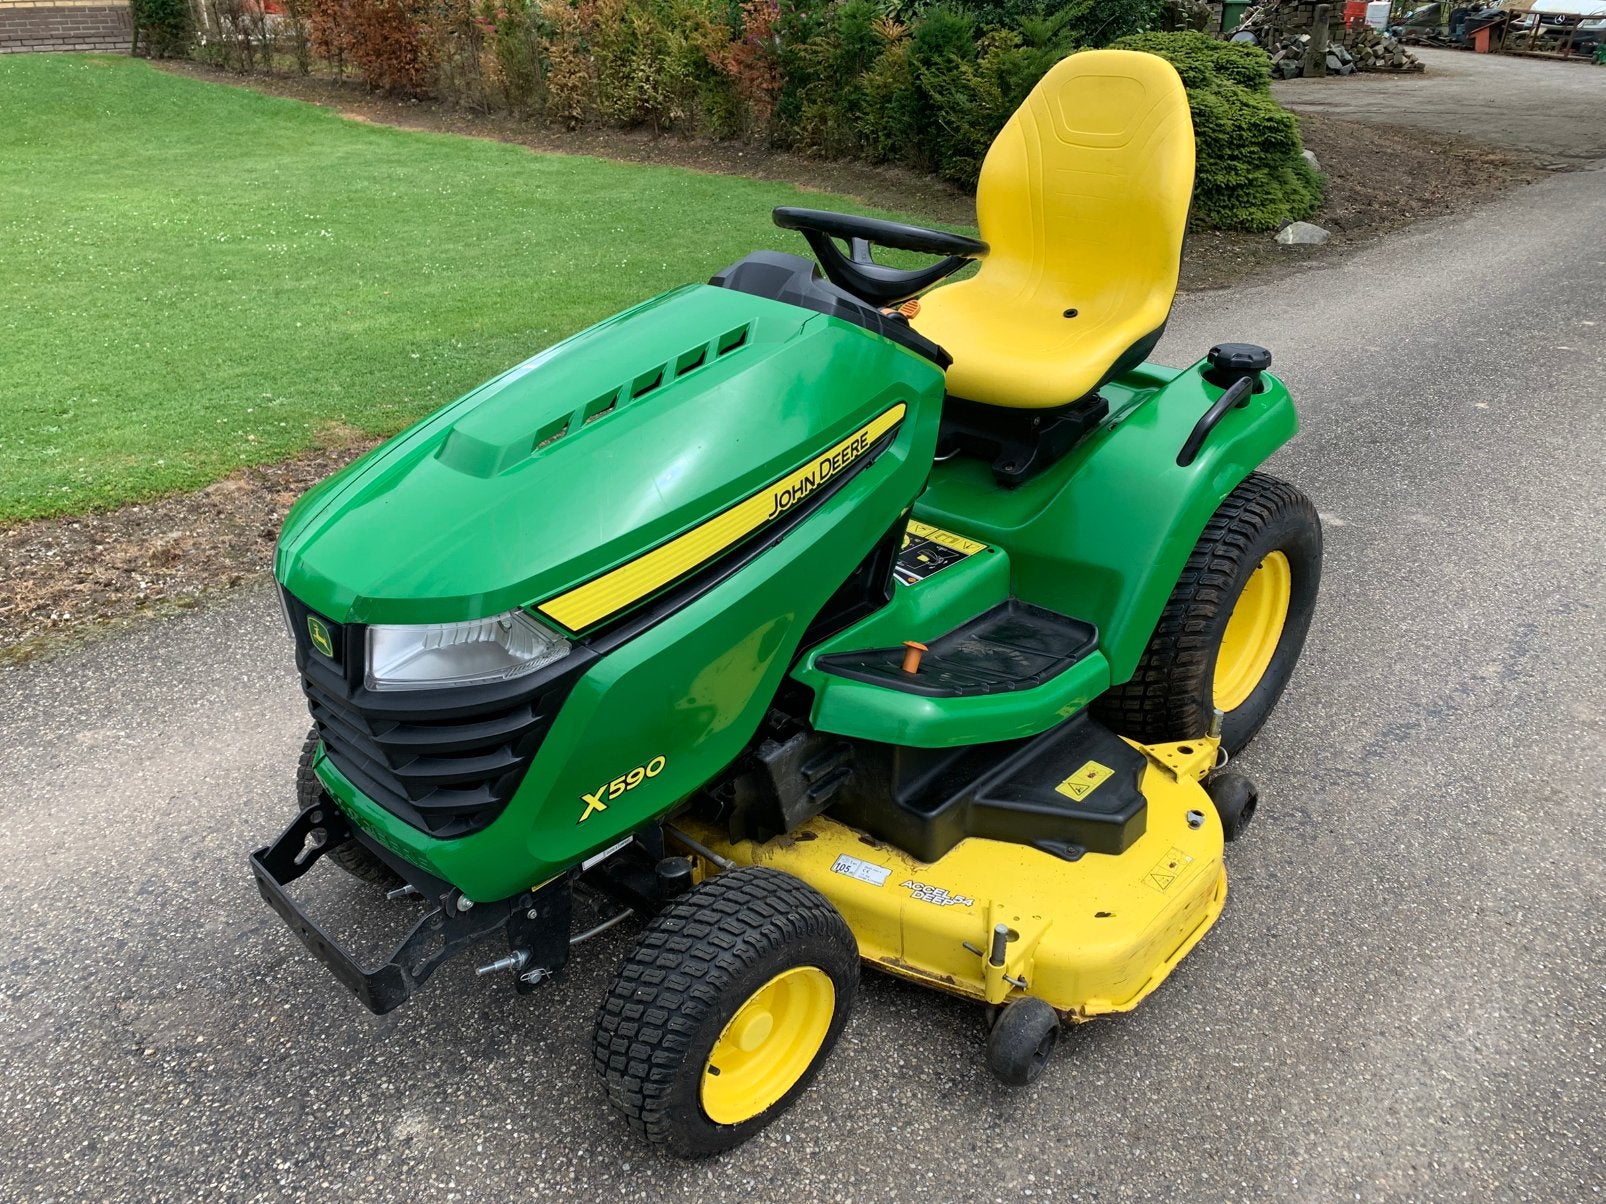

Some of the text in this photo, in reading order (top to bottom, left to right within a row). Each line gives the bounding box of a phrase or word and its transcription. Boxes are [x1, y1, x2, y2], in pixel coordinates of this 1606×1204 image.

[769, 431, 869, 519] JOHN DEERE
[577, 754, 666, 823] X590
[834, 862, 852, 873] 105
[899, 880, 975, 907] ACCEL 54
[910, 890, 955, 906] DEEP
